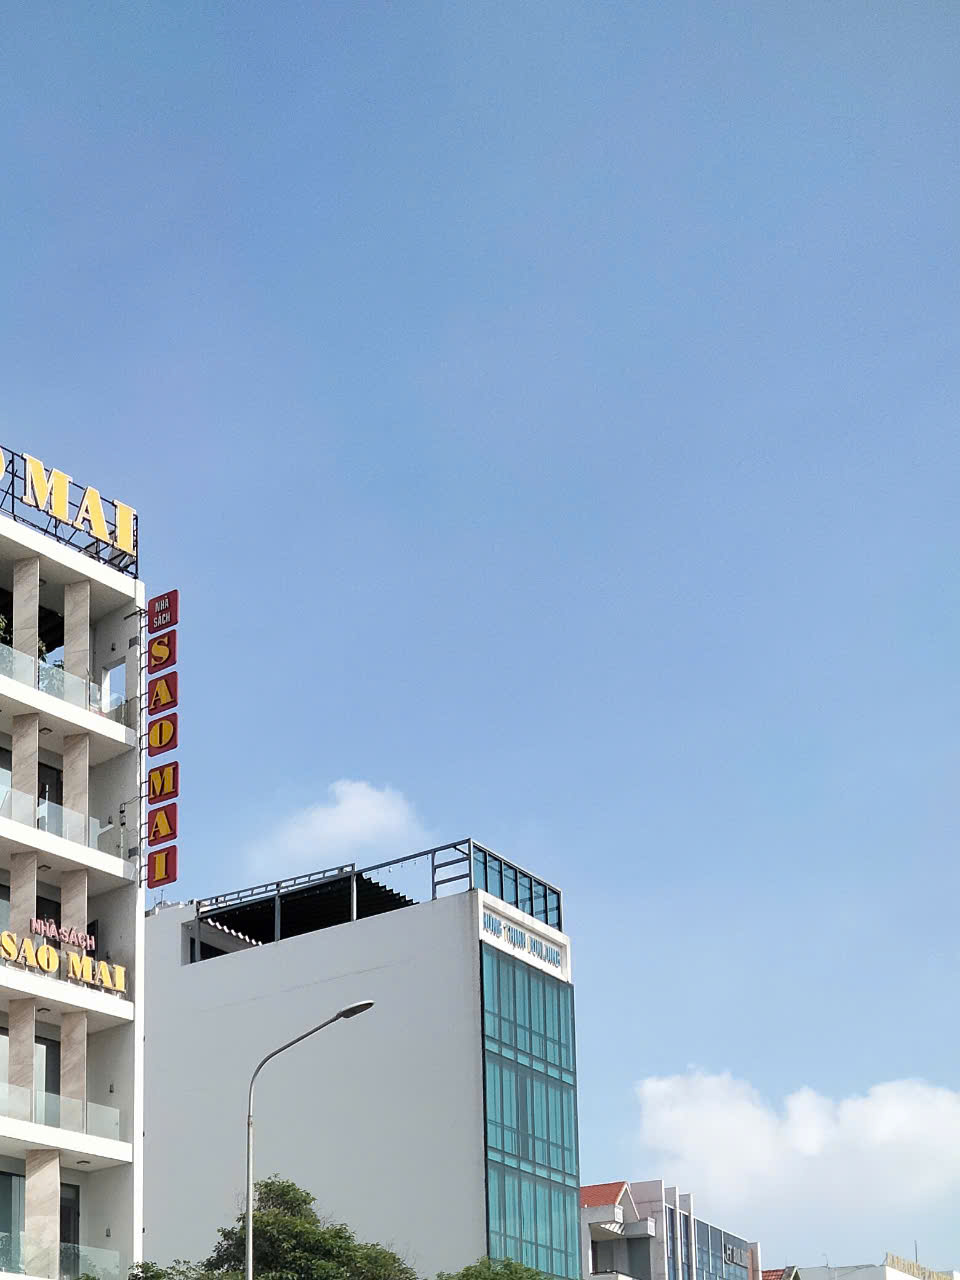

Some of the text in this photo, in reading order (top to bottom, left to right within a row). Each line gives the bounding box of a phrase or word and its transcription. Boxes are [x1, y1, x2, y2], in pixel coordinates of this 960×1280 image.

[20, 453, 137, 557] MAI
[153, 612, 172, 629] SÁCH
[154, 595, 170, 612] NHÀ
[149, 636, 176, 883] SAO MAI
[31, 917, 96, 951] NHÀ SÁCH
[0, 930, 128, 993] SAO MAI
